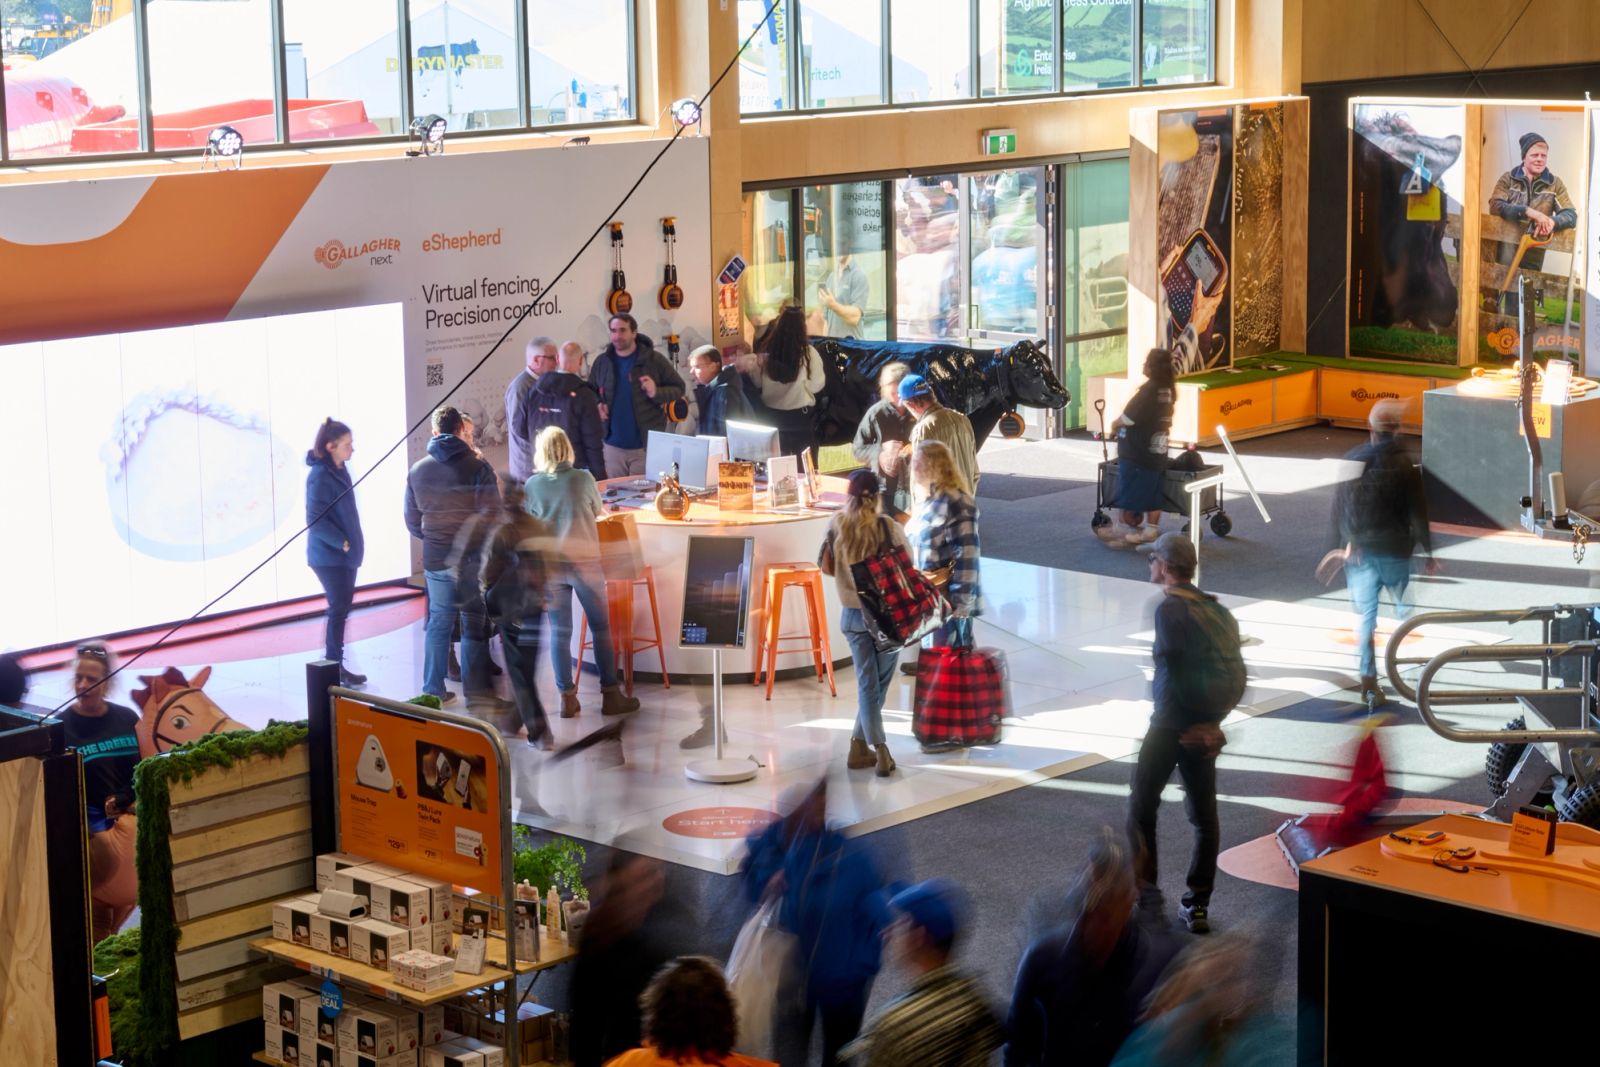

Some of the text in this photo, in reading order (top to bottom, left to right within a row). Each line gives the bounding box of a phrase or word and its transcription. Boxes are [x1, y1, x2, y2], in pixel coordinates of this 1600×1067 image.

[1034, 63, 1053, 75] Irela
[327, 238, 401, 262] GALLAGHER
[422, 228, 501, 252] eShepherd
[370, 254, 393, 266] next
[422, 275, 544, 304] Virtual fencing.
[426, 295, 562, 329] Precision control.
[1499, 334, 1581, 351] GAAGHER
[1357, 391, 1401, 400] GALLAGHER
